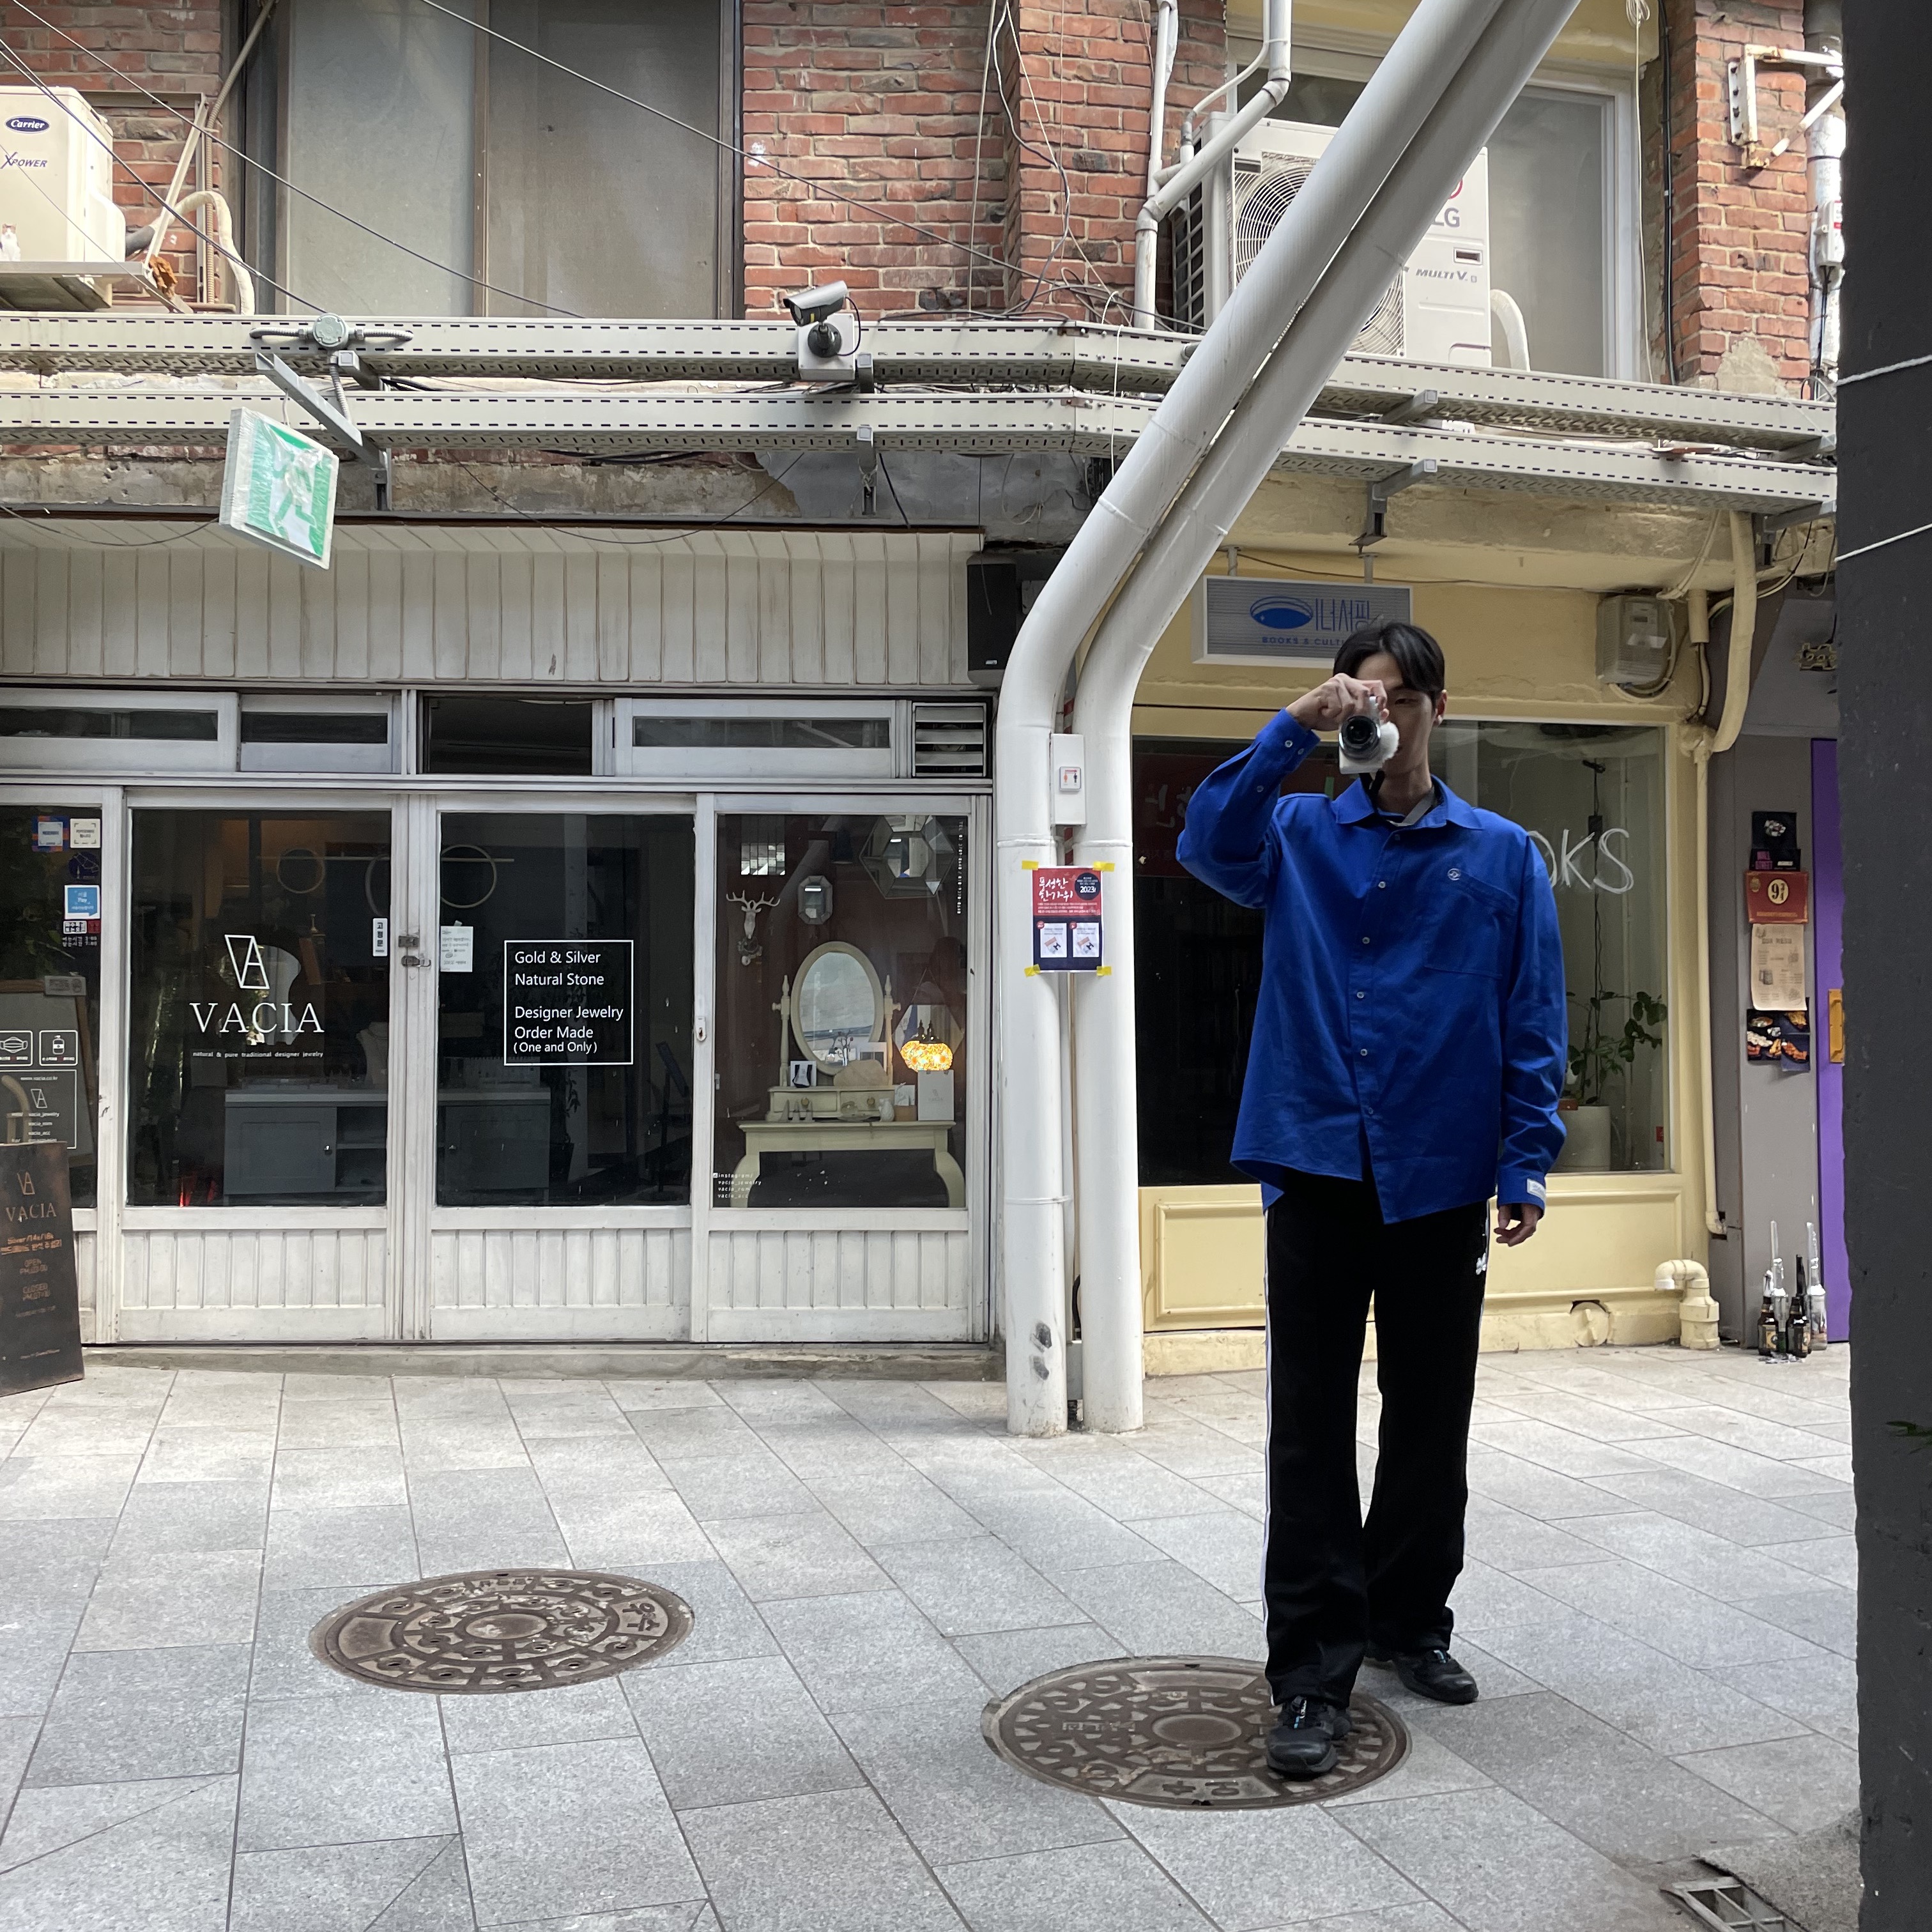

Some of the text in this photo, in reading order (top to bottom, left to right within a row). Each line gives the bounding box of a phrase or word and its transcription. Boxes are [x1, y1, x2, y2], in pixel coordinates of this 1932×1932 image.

[11, 119, 45, 128] Carrier
[1416, 269, 1454, 280] MULTI
[1262, 636, 1299, 645] BOOKS
[1039, 890, 1073, 902] 한가위
[515, 951, 601, 964] Gold & Silver
[515, 973, 604, 986] Natural Stone
[189, 1002, 325, 1034] VACIA
[514, 1006, 624, 1022] Designer Jewelry
[514, 1026, 594, 1039] Order Made
[513, 1041, 598, 1055] (One and Only)
[4, 1202, 57, 1222] VACIA
